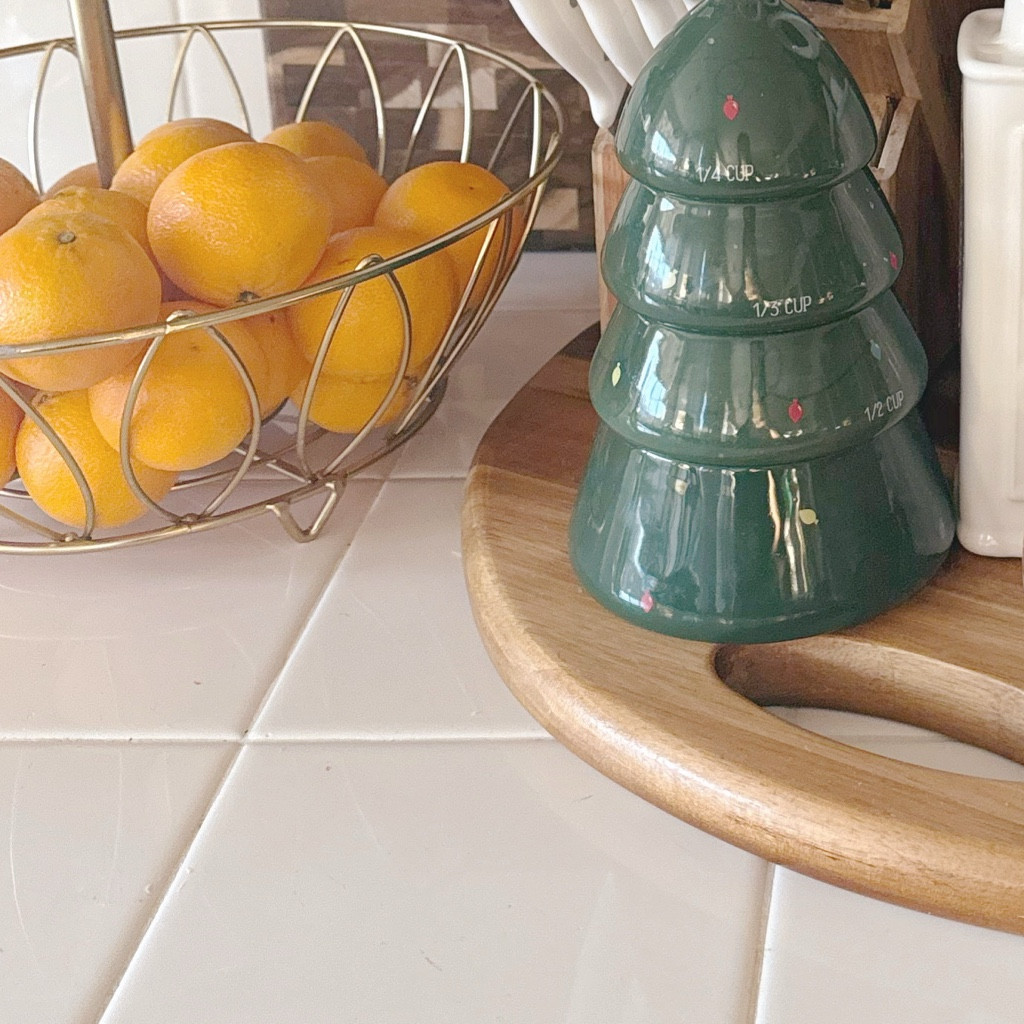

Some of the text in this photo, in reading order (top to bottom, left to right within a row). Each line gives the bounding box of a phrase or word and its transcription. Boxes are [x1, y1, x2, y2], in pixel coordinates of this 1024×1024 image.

[696, 164, 754, 182] 1/4 CUP
[752, 295, 812, 319] 1/3 CUP
[864, 390, 905, 423] 1/2 CUP
